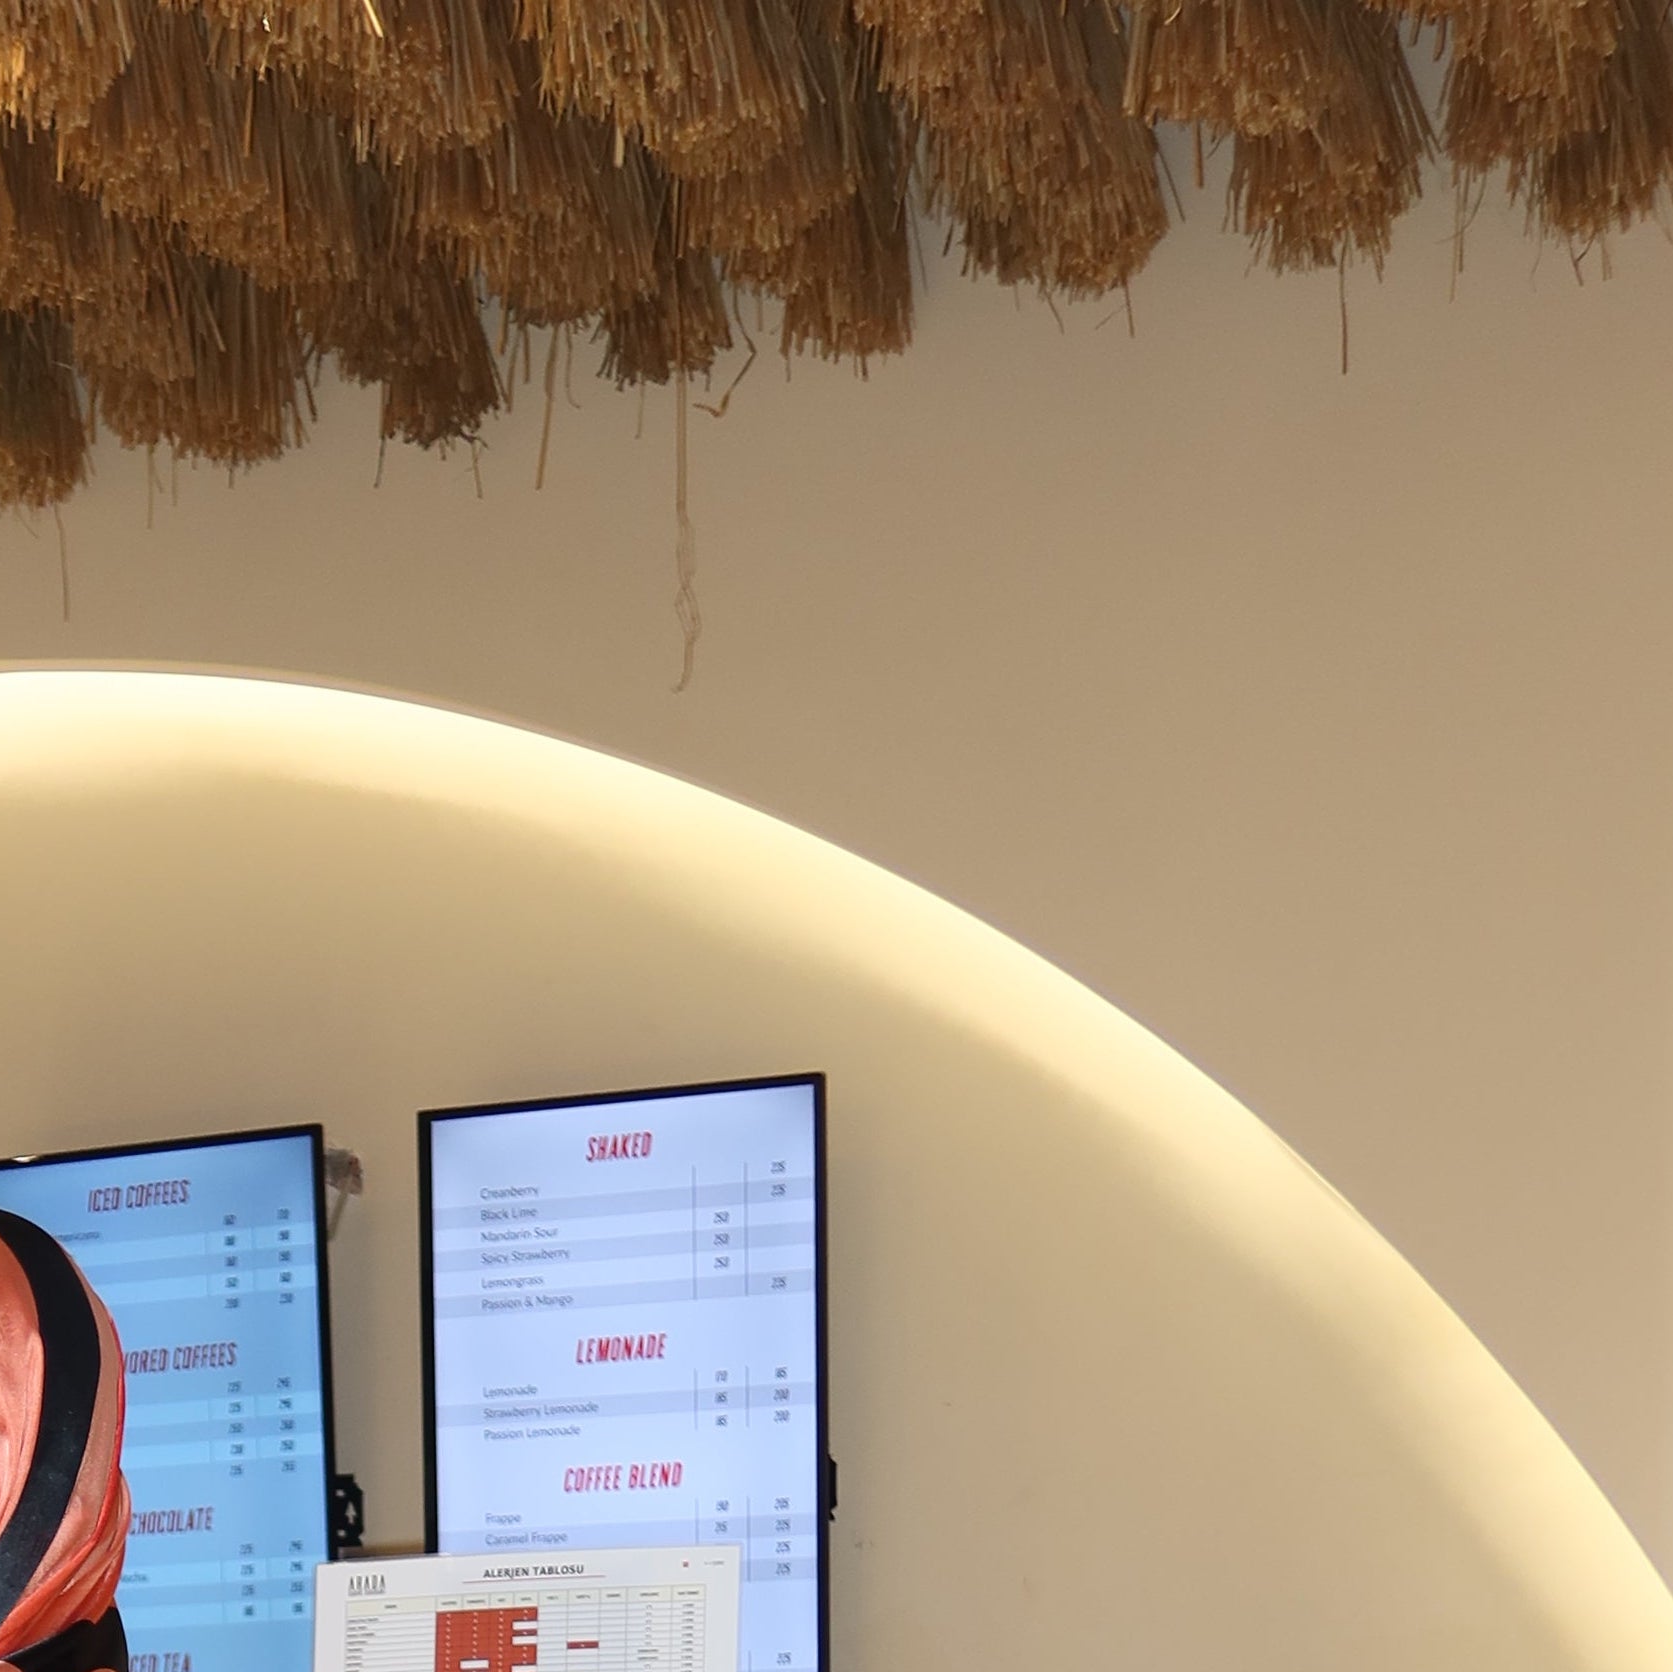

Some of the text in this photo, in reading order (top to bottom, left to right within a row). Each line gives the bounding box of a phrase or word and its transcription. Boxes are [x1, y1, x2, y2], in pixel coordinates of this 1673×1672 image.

[586, 1131, 652, 1162] SHAKED
[88, 1179, 190, 1213] ICED COFFEES
[482, 1298, 522, 1310] Passion
[173, 1342, 237, 1370] COFFEES
[576, 1333, 667, 1364] LEMONADE
[483, 1384, 538, 1399] Lemonade
[483, 1401, 599, 1419] Strawberry Lemonade
[484, 1424, 581, 1441] Passion Lemonade
[564, 1461, 683, 1493] COFFEE BLEND
[130, 1507, 214, 1535] CHOCOLATE
[485, 1513, 522, 1525] Frappe
[485, 1532, 568, 1546] Caramel Frappe
[483, 1565, 585, 1580] ALERJEN TABLOSU
